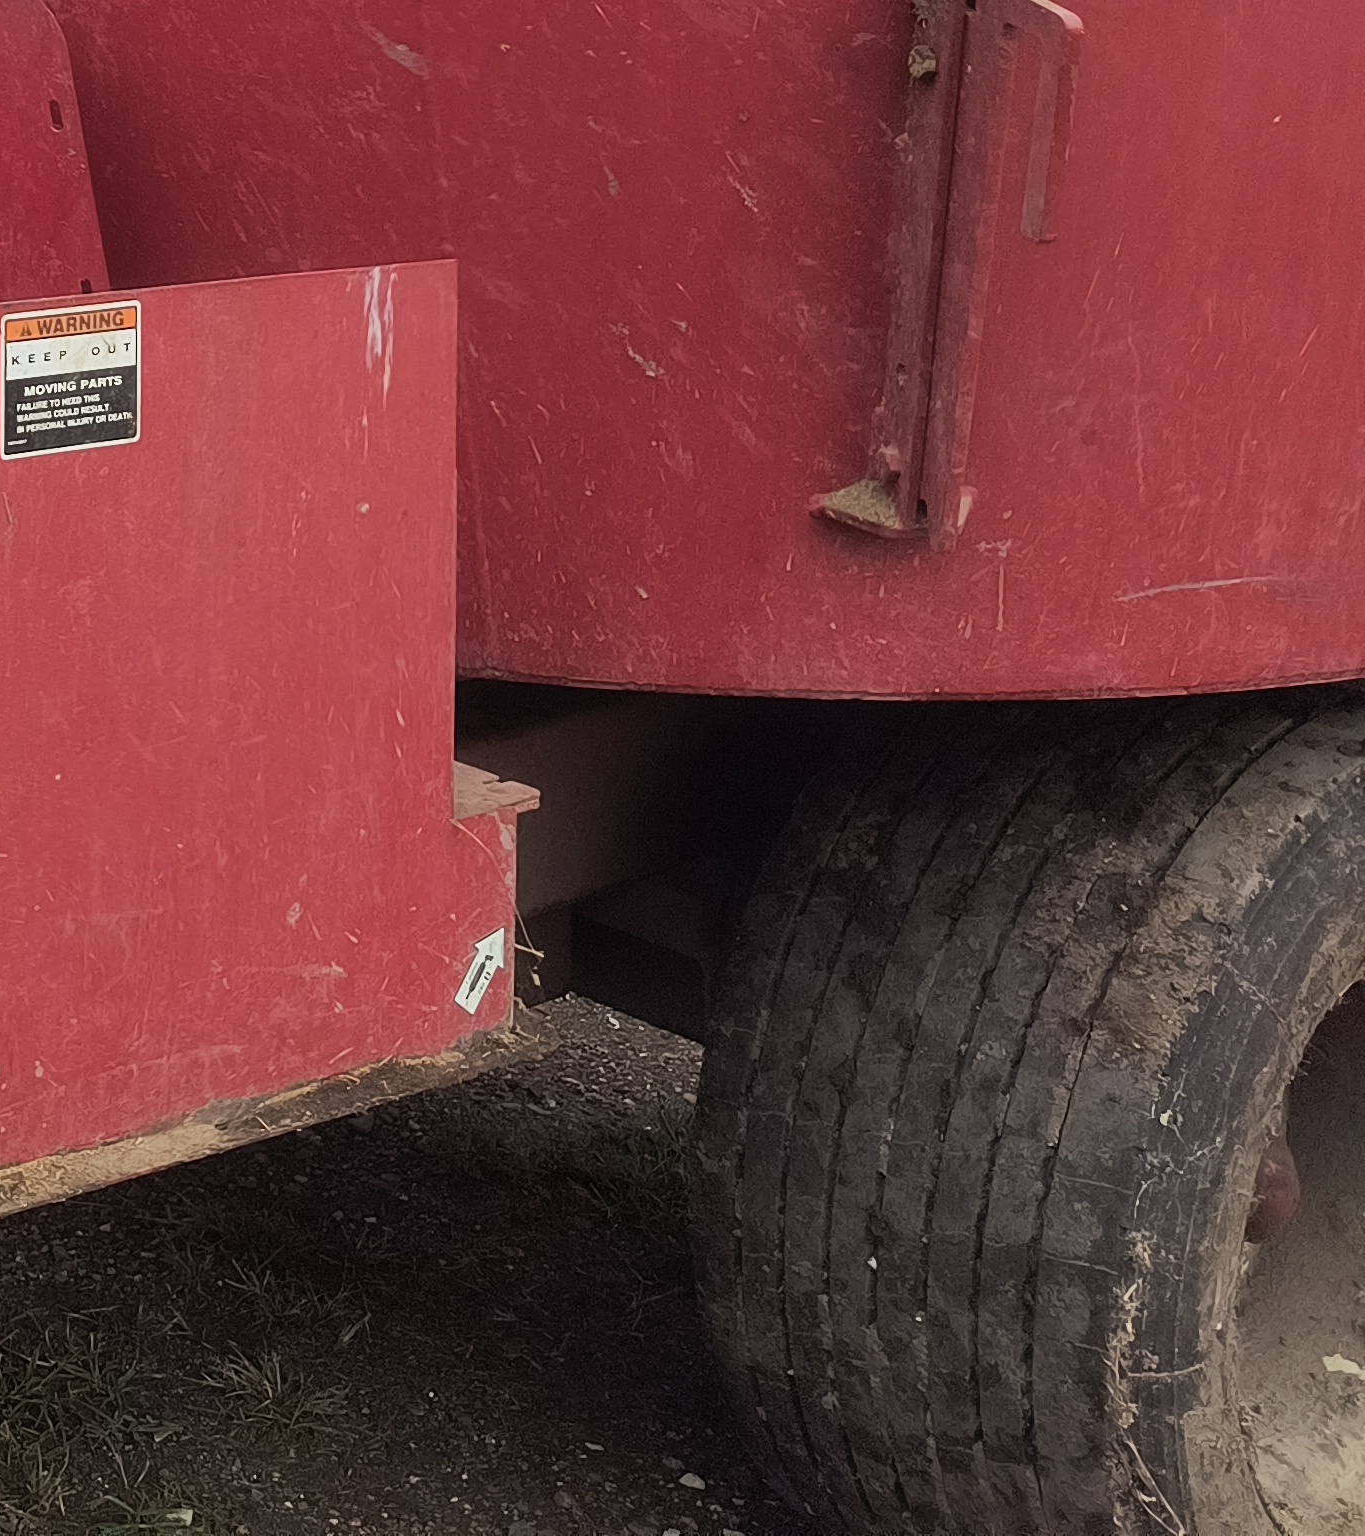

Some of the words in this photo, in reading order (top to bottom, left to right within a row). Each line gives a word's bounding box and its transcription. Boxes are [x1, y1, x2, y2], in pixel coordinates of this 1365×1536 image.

[37, 311, 125, 336] WARNING
[24, 381, 77, 397] MOVING
[81, 376, 123, 390] PARTS
[17, 400, 49, 412] FAILURE
[50, 399, 61, 408] TO
[62, 396, 83, 407] HEED
[84, 394, 101, 404] THIS
[17, 411, 53, 423] WARNING
[54, 408, 79, 418] COULD
[81, 404, 110, 415] RESULT
[17, 426, 25, 434] IN
[26, 421, 67, 433] PERSONAL
[67, 416, 94, 428] INJURY
[96, 415, 107, 424] OR
